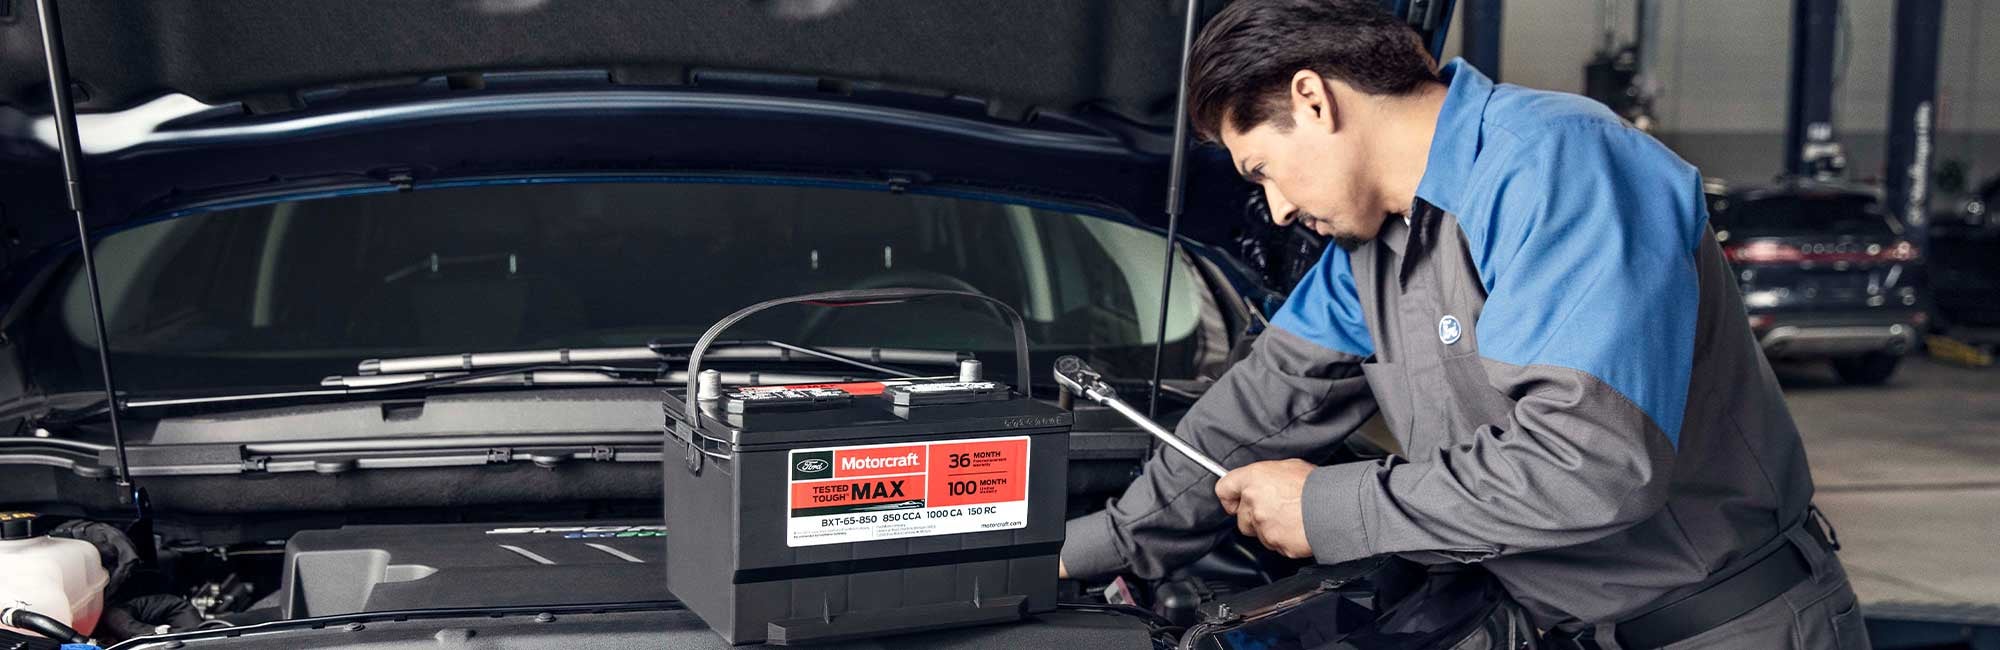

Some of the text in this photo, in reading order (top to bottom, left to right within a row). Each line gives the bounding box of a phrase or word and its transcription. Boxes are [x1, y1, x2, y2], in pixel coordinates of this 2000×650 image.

[801, 460, 823, 471] Ford
[841, 452, 919, 470] Motorcraft
[949, 453, 971, 468] 36
[812, 485, 849, 494] TESTED
[851, 480, 905, 501] MAX
[948, 481, 977, 496] 100
[979, 478, 1007, 486] MONTH
[813, 494, 846, 503] TOUGH
[821, 506, 997, 527] BXT-65-850 850 CCA 1000 CA 150 RC
[981, 520, 1022, 528] motorcraft.com
